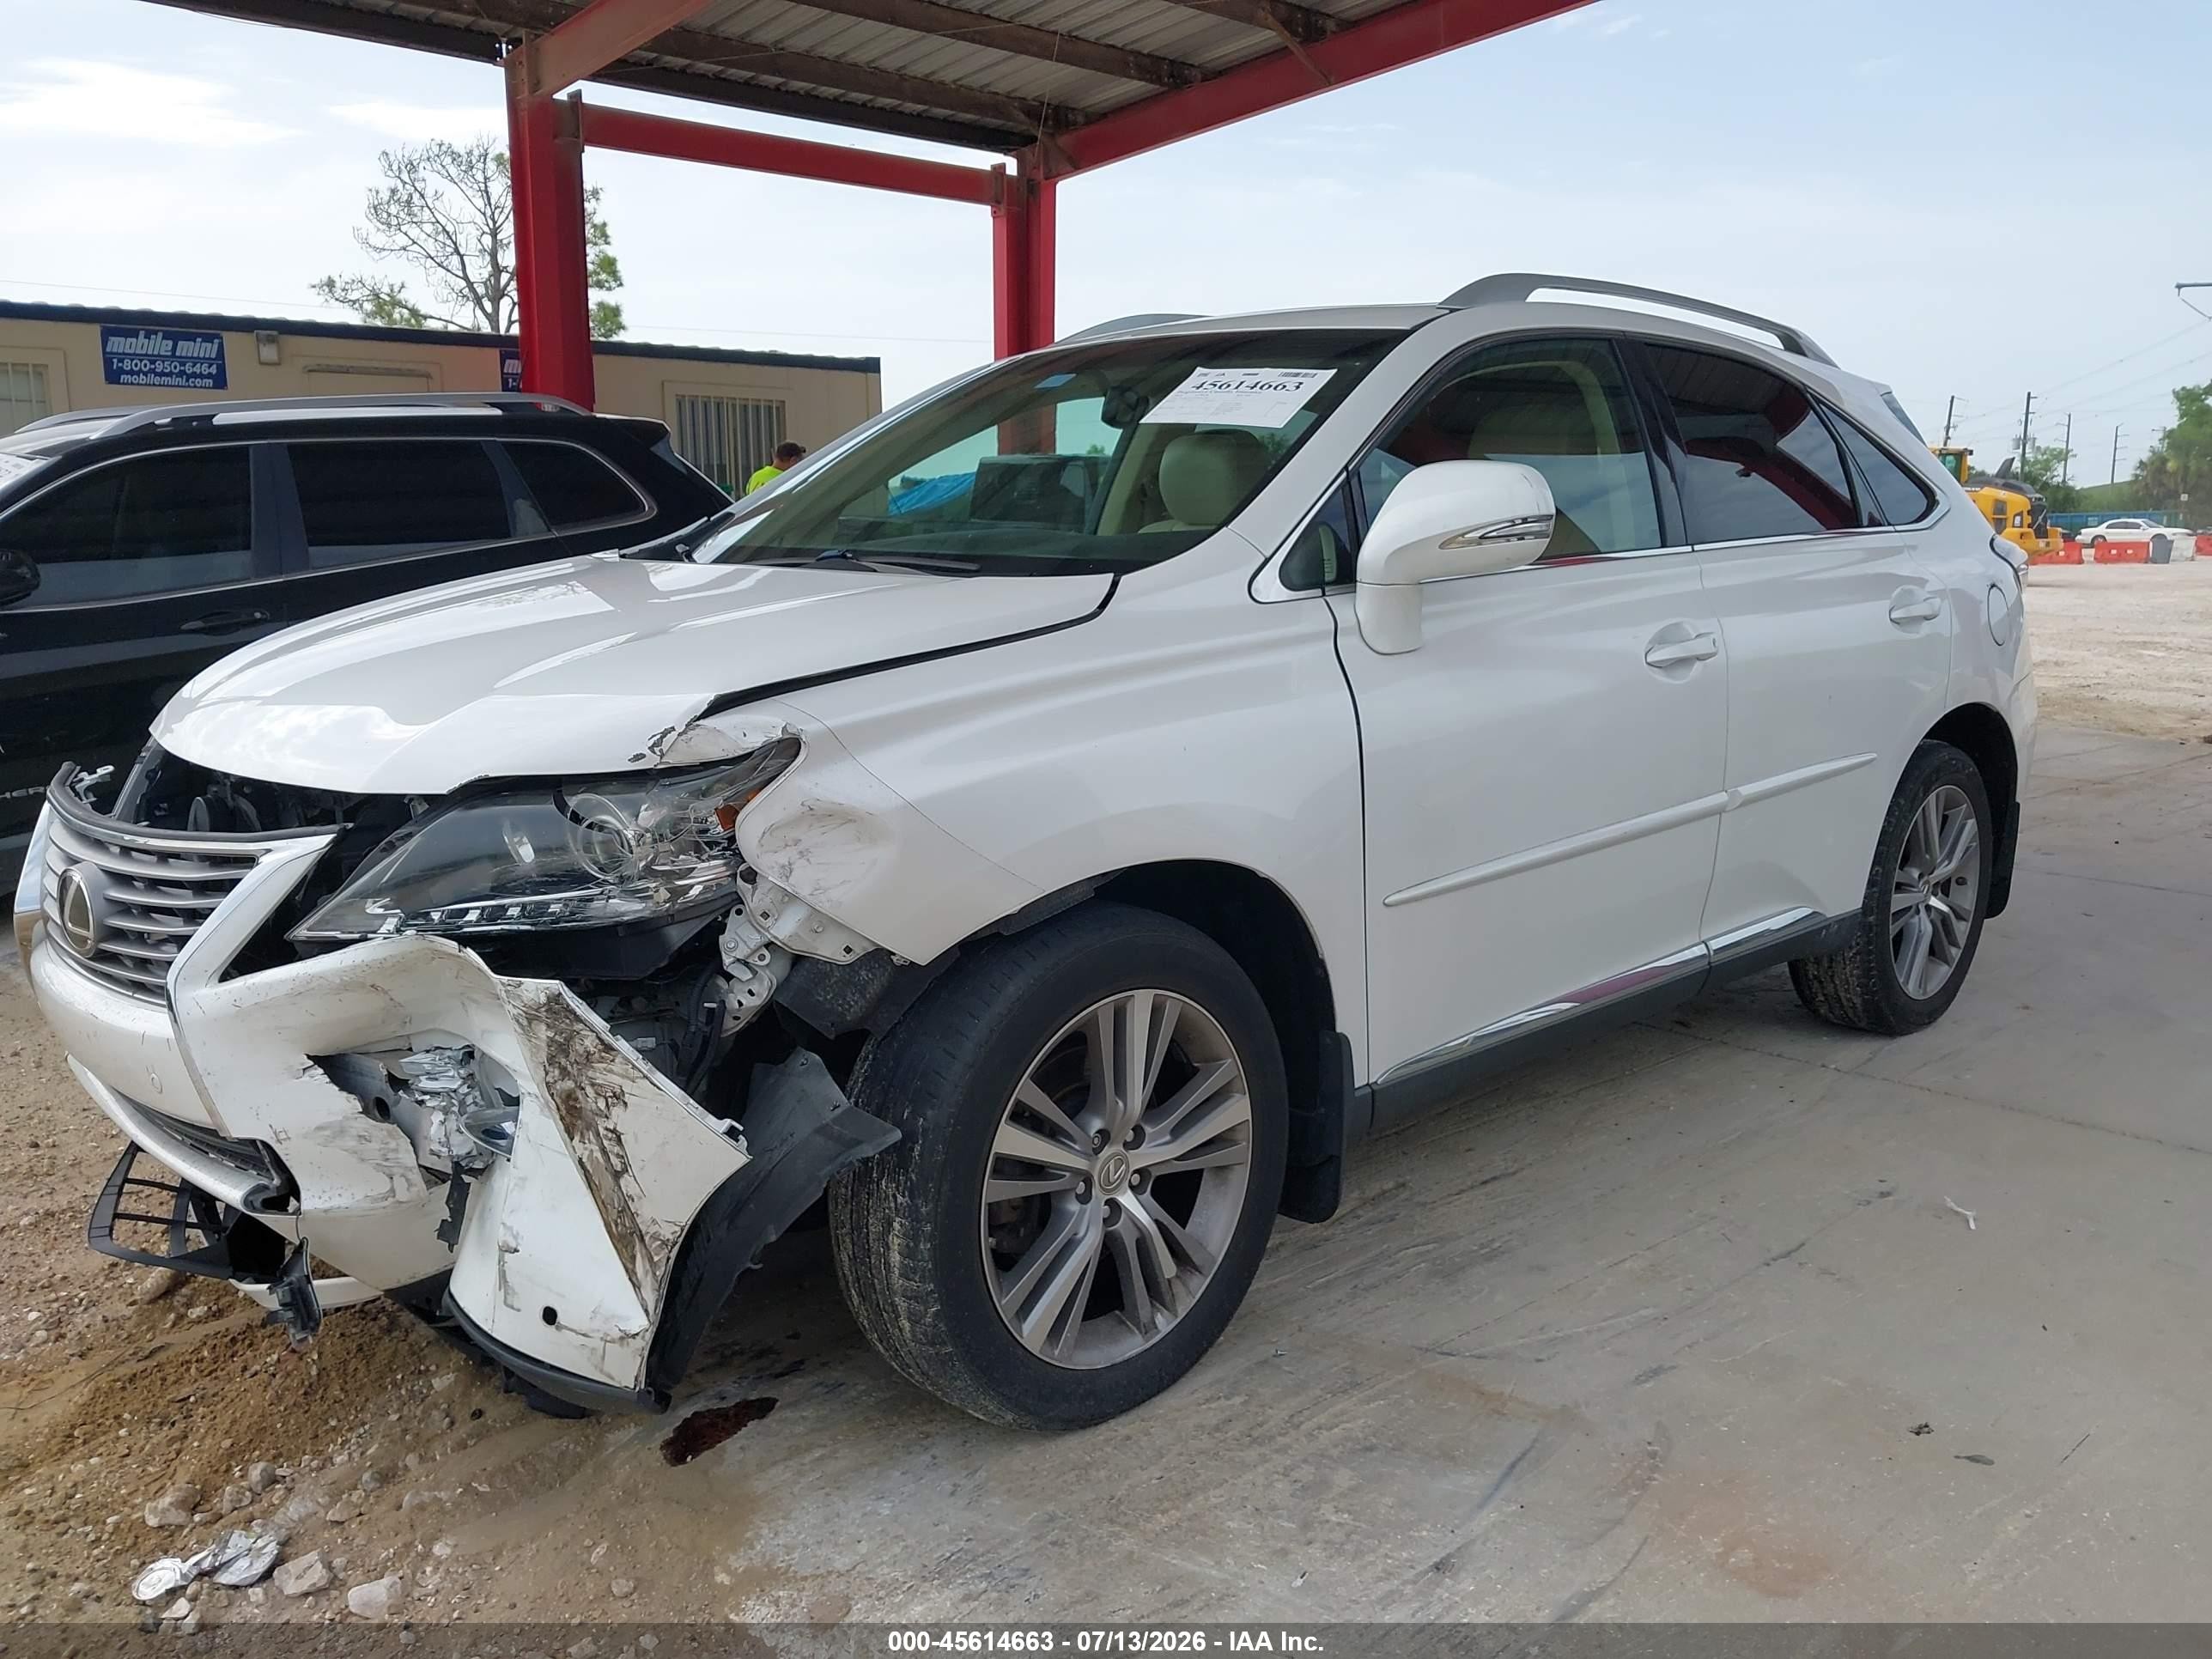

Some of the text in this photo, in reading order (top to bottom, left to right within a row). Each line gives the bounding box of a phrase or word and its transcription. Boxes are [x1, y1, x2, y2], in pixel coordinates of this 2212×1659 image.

[106, 331, 220, 359] mobile mini
[112, 358, 217, 374] 1-800-950-6464
[119, 373, 214, 387] mobilemini.com
[1191, 380, 1304, 392] 45614663
